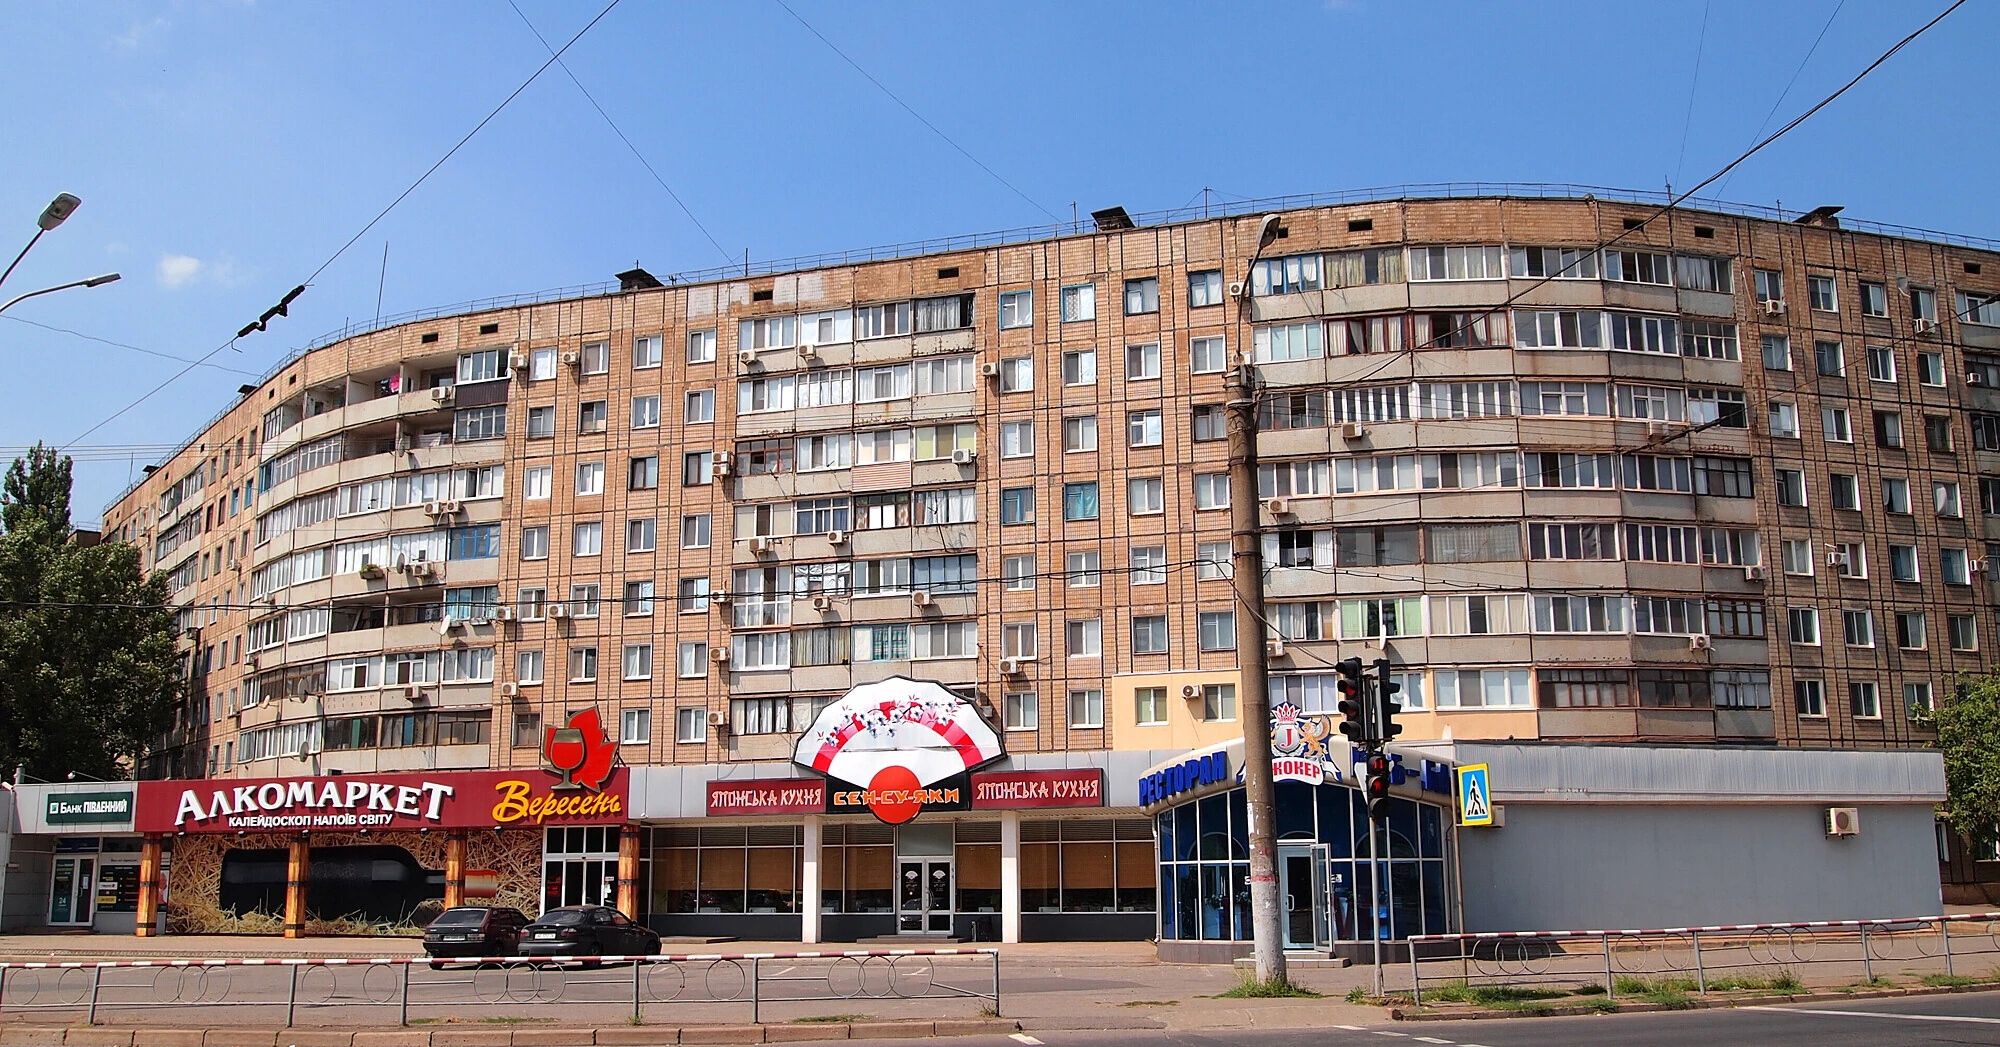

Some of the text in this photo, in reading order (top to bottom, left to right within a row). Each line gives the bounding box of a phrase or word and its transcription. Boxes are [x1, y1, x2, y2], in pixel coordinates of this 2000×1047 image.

[1280, 728, 1293, 748] J
[976, 779, 1099, 800] ЯПОНСЬКА КУХНЯ
[1139, 751, 1227, 807] РЕСТОРАН
[83, 799, 128, 813] ПІВДЕННИЙ
[174, 781, 454, 827] АЛКОМАРКЕТ
[492, 780, 622, 825] Вересень
[710, 787, 822, 808] ЯПОНСЬКА КУХНЯ
[833, 788, 960, 806] СЕН-СУ-ЯКИ
[228, 812, 393, 828] КАЛЕЙДОСКОП НАПОЇВ СВІТУ
